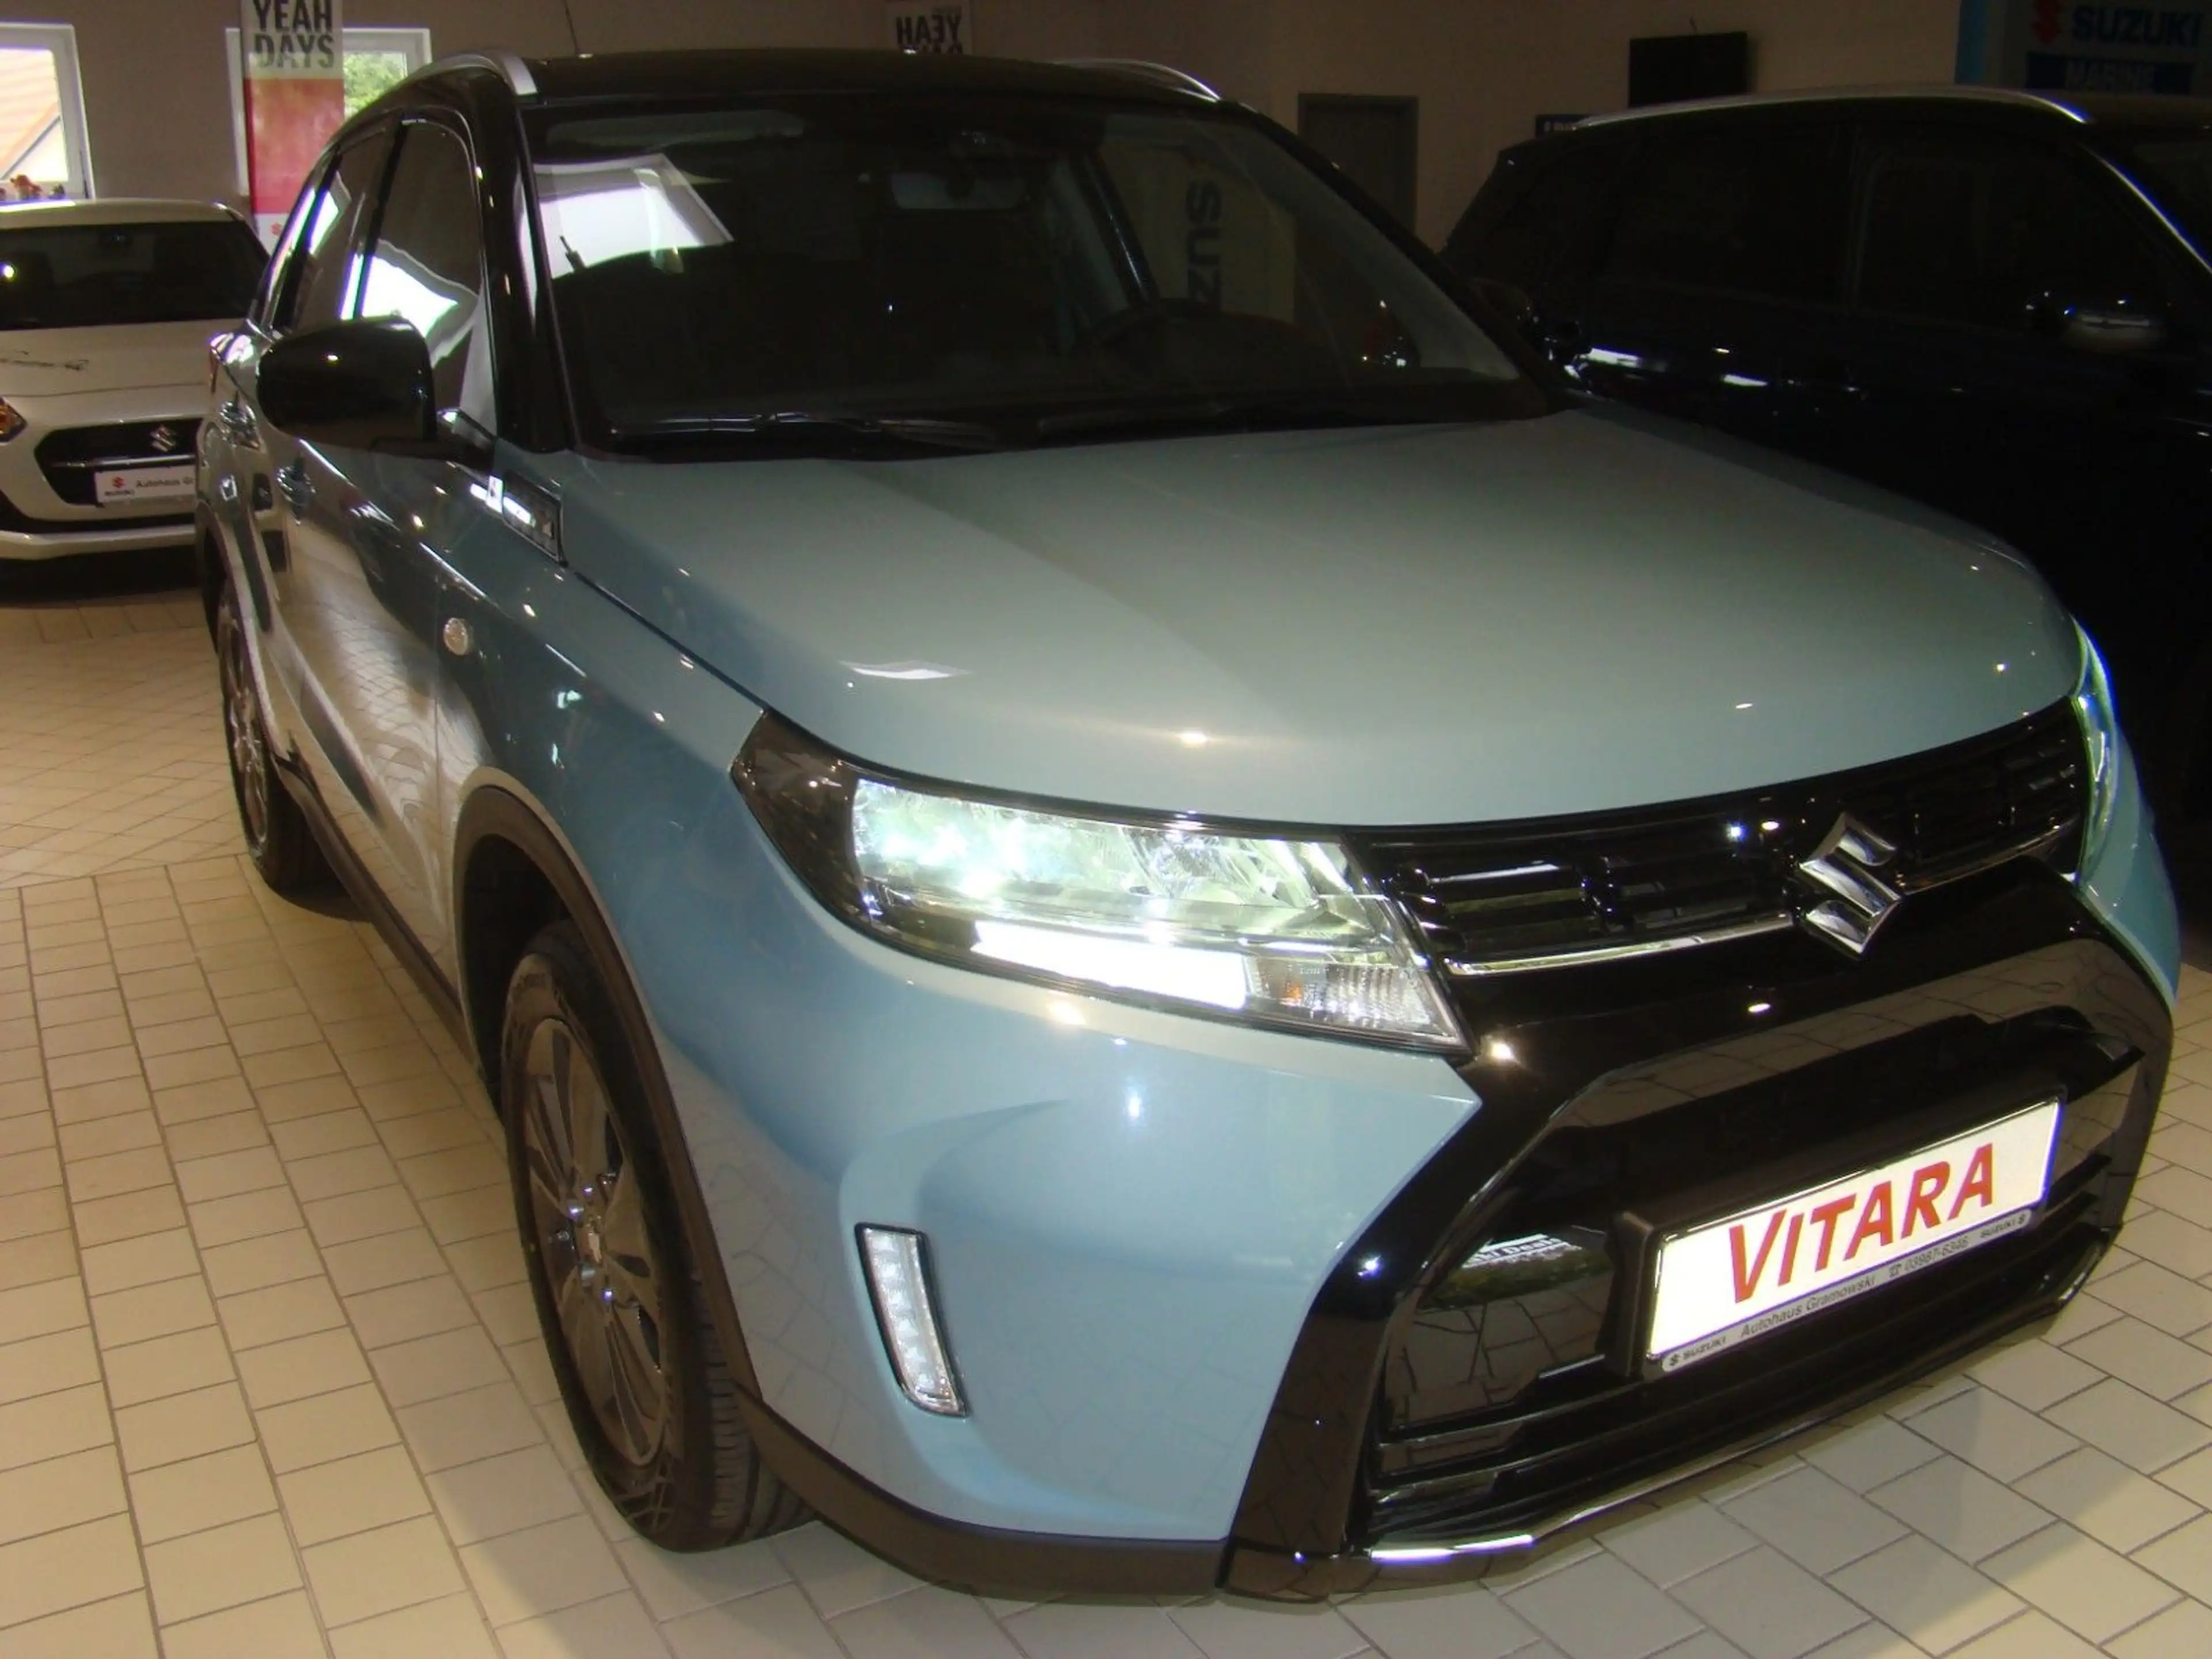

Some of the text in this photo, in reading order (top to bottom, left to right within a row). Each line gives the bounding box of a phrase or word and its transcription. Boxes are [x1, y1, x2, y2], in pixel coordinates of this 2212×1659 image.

[253, 0, 332, 31] YEAH
[2072, 5, 2203, 47] SUZUKI
[255, 34, 335, 68] DAYS
[1729, 1142, 1993, 1304] VITARA
[1740, 1304, 1803, 1338] Autohaus
[1806, 1276, 1876, 1316] Gramowski
